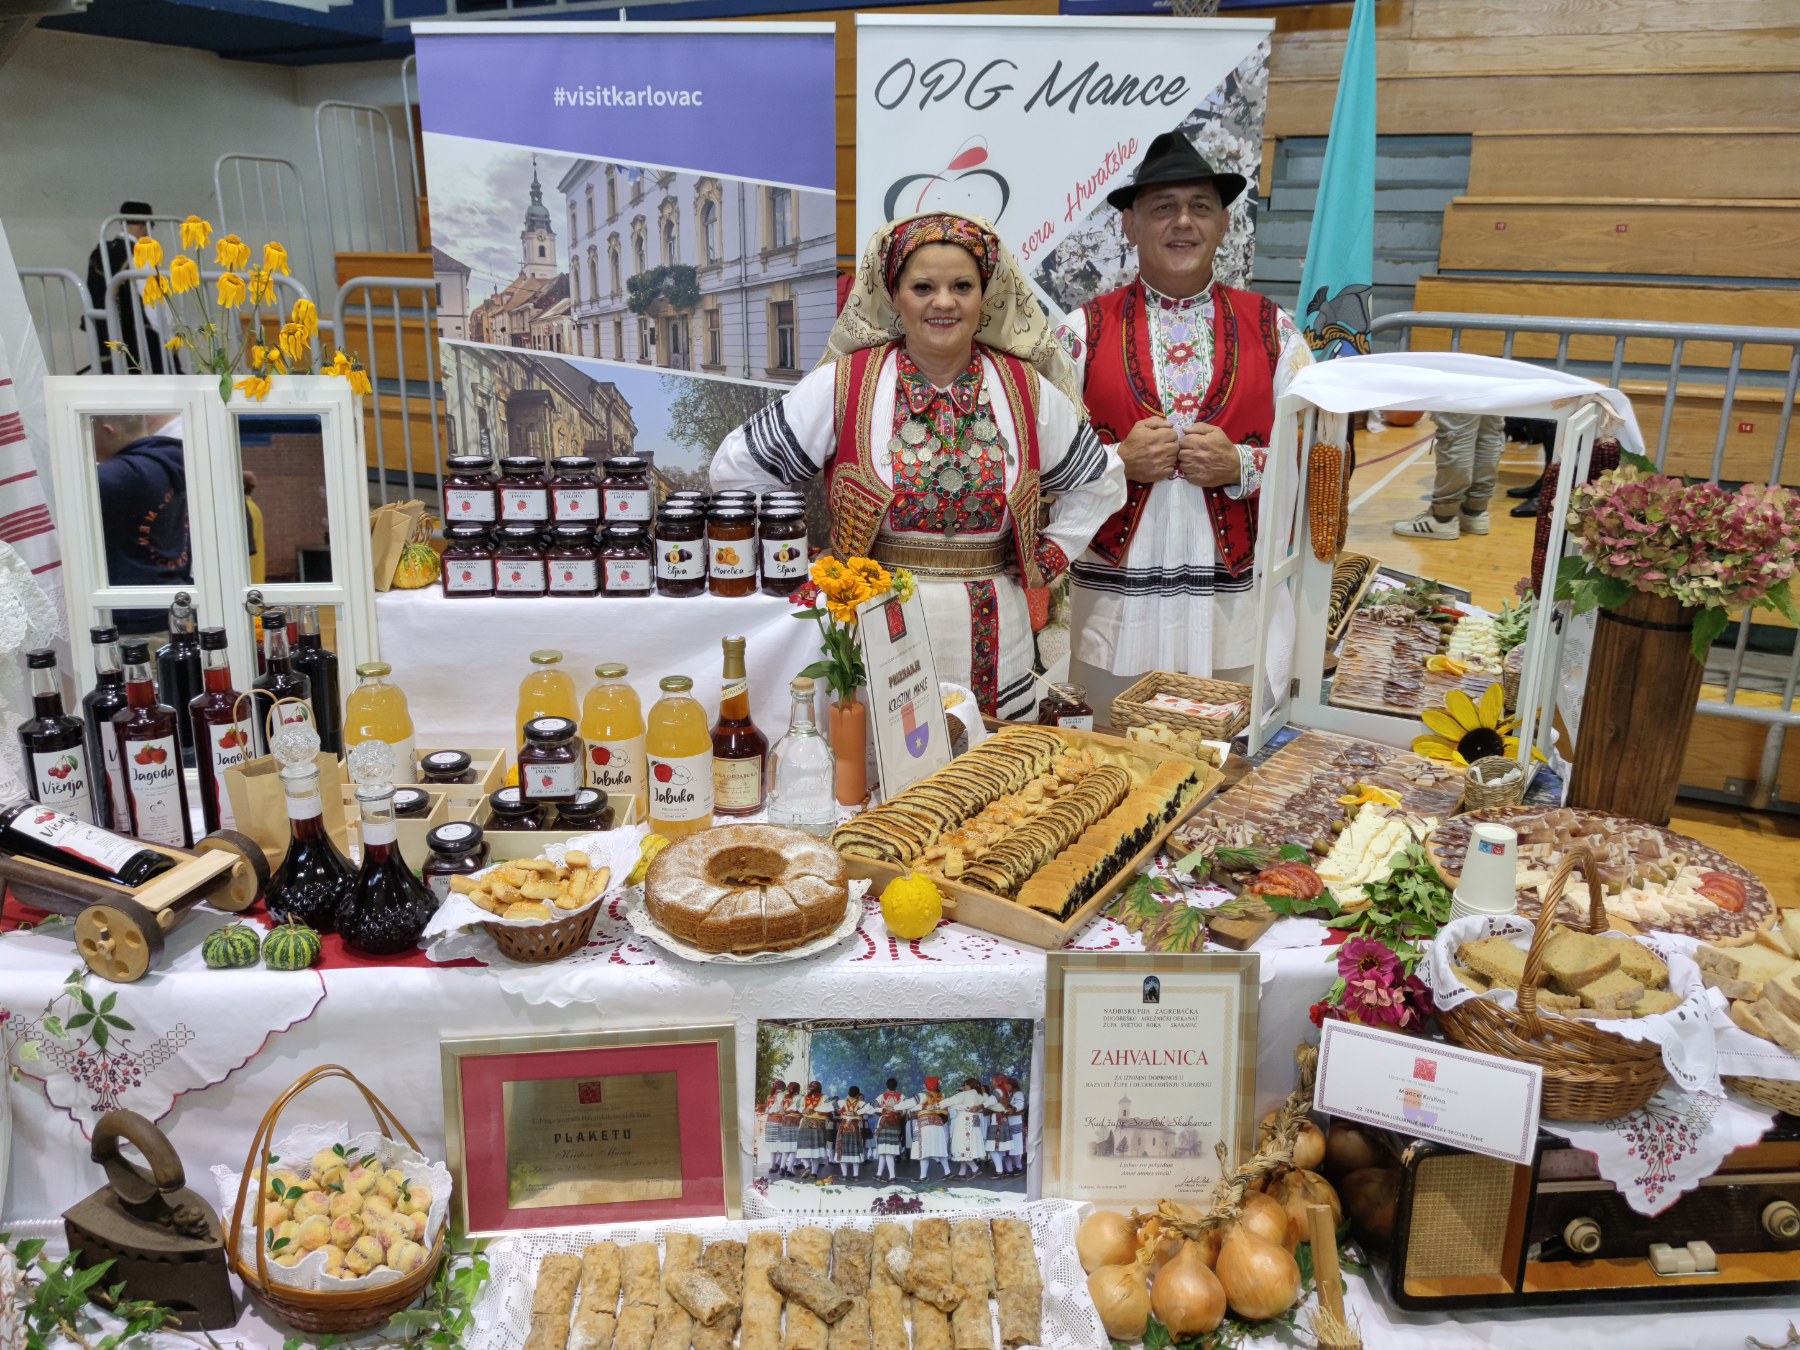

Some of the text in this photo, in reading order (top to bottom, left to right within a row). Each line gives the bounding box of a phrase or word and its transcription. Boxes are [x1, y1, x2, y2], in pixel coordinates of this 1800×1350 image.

[874, 57, 1191, 114] OPG Mance
[553, 84, 703, 107] #visitkarlovac
[1064, 137, 1139, 223] Hrvatske
[132, 765, 175, 785] Jagoda
[591, 770, 632, 786] Jabuka
[41, 779, 84, 798] Višnja
[654, 787, 695, 804] Jabuka
[1091, 1049, 1209, 1066] ZAHVALNICA
[1398, 1088, 1446, 1105] Mance Kristina
[1167, 1115, 1212, 1127] Skakavac
[554, 1128, 632, 1144] PLAKETU
